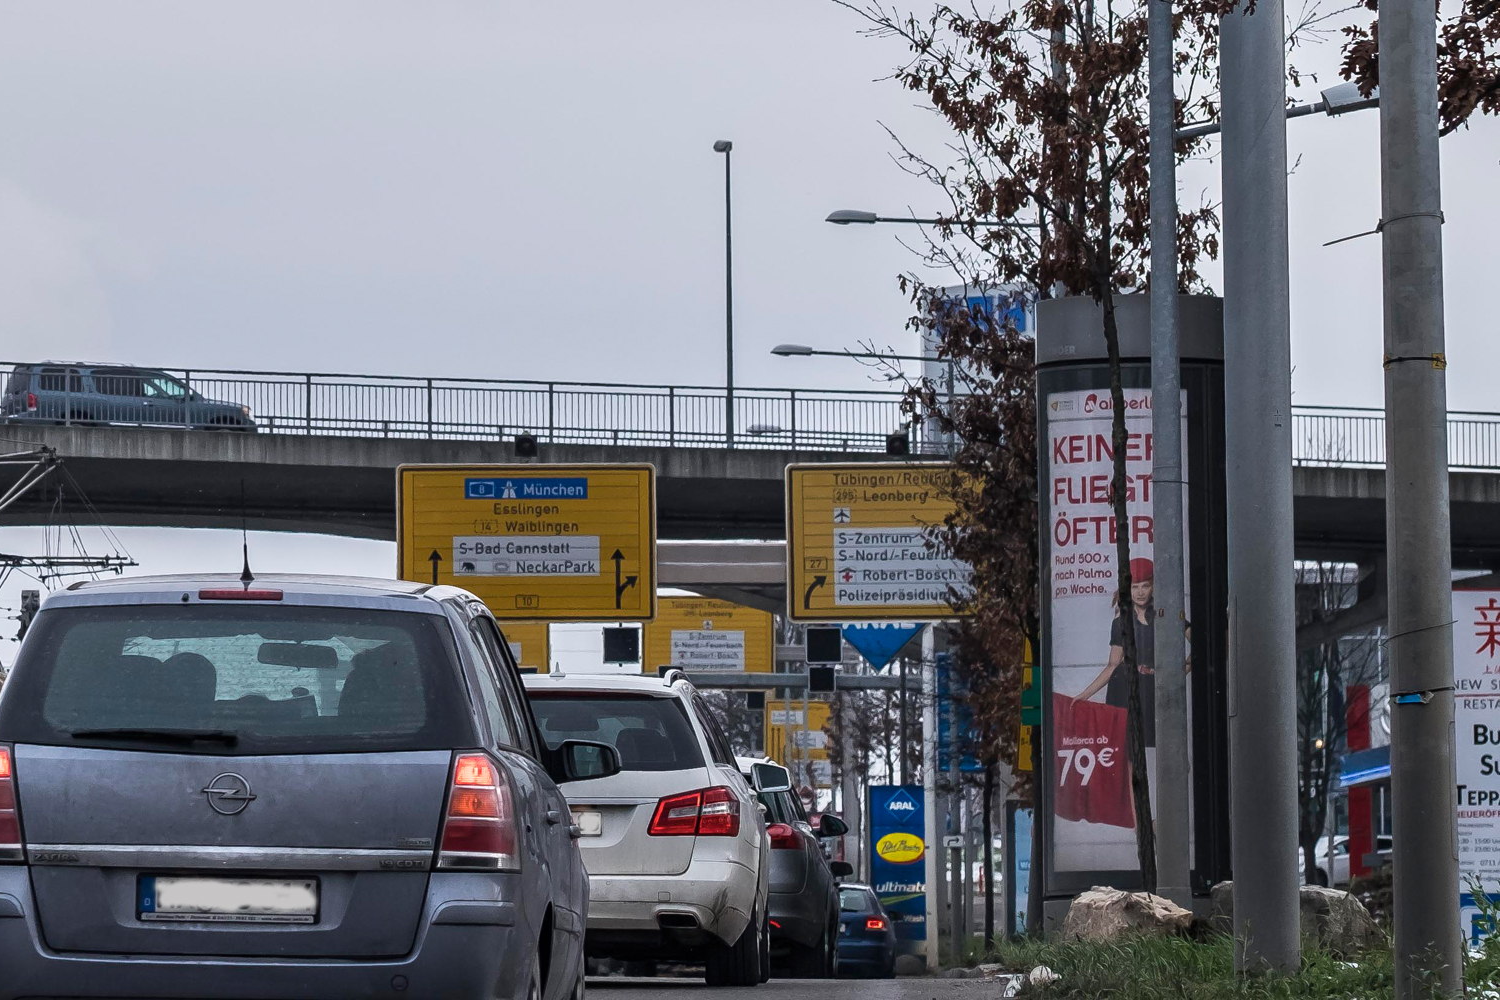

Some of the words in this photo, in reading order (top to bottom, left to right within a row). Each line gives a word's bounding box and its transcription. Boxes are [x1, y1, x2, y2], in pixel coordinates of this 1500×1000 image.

[523, 482, 584, 496] München
[863, 489, 928, 504] Leonberg
[493, 502, 559, 517] Esslingen
[480, 521, 492, 532] 14
[505, 521, 579, 535] Waiblingen
[838, 532, 912, 545] S-Zentrum
[459, 542, 500, 555] S-Bad
[506, 542, 570, 554] Cannstatt
[810, 559, 822, 568] 27
[1055, 553, 1075, 565] Rund
[1078, 553, 1101, 564] 500
[516, 560, 595, 574] NeckarPark
[863, 569, 957, 581] Robert-Bosch
[1055, 569, 1074, 580] nach
[1078, 568, 1112, 578] Palma
[1055, 587, 1067, 597] pro
[1070, 583, 1107, 594] Woche.
[522, 596, 533, 606] 10
[1096, 735, 1109, 744] ab
[889, 801, 915, 811] ARAL
[34, 852, 79, 862] ZAFIRA
